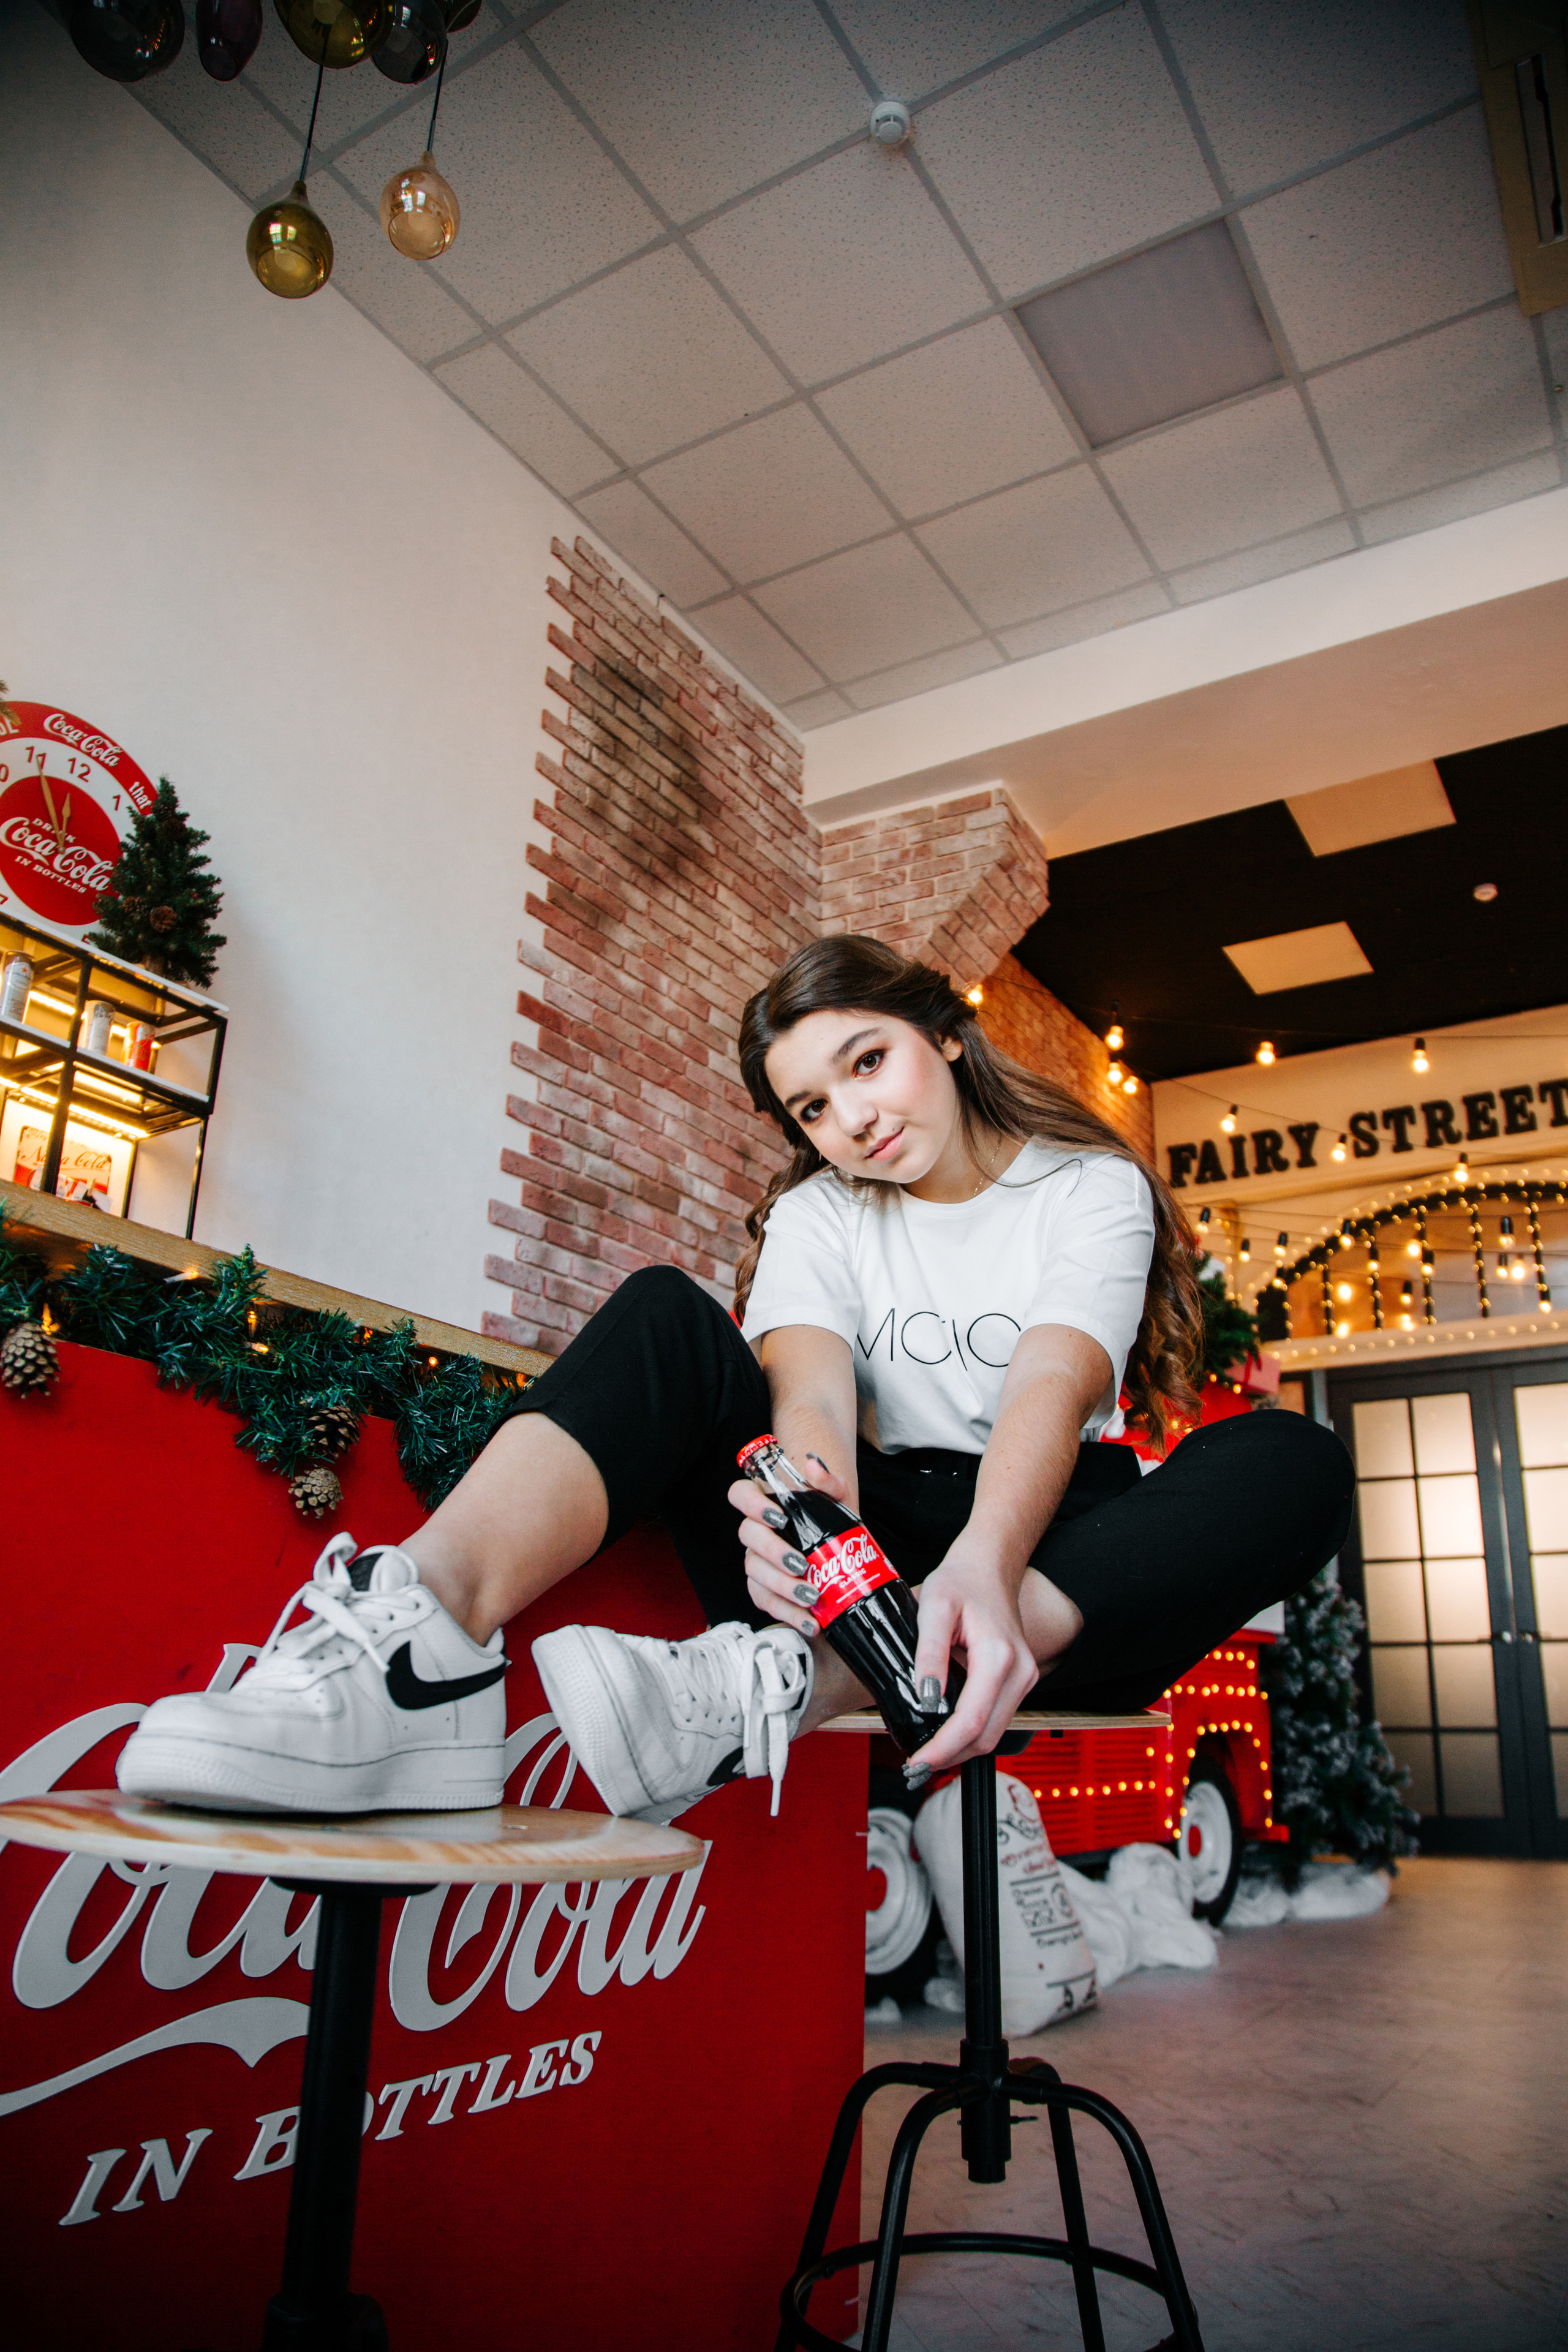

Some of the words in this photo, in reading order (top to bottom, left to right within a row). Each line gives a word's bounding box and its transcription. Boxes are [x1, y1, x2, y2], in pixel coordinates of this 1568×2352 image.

[43, 713, 124, 766] Coca-Cola
[25, 745, 47, 771] 11
[67, 757, 91, 783] 12
[112, 794, 121, 812] 1
[129, 781, 153, 810] that
[32, 817, 77, 843] DRK
[15, 855, 32, 866] IN
[32, 864, 88, 894] BOTTLES
[1167, 1122, 1319, 1188] FAIRY
[1349, 1078, 1568, 1159] STREET
[21, 1145, 70, 1166] Na
[839, 1567, 867, 1588] CLASSIC
[0, 1702, 714, 2117] CocaCola
[58, 2128, 214, 2226] IN
[233, 2030, 602, 2181] BTTLES
